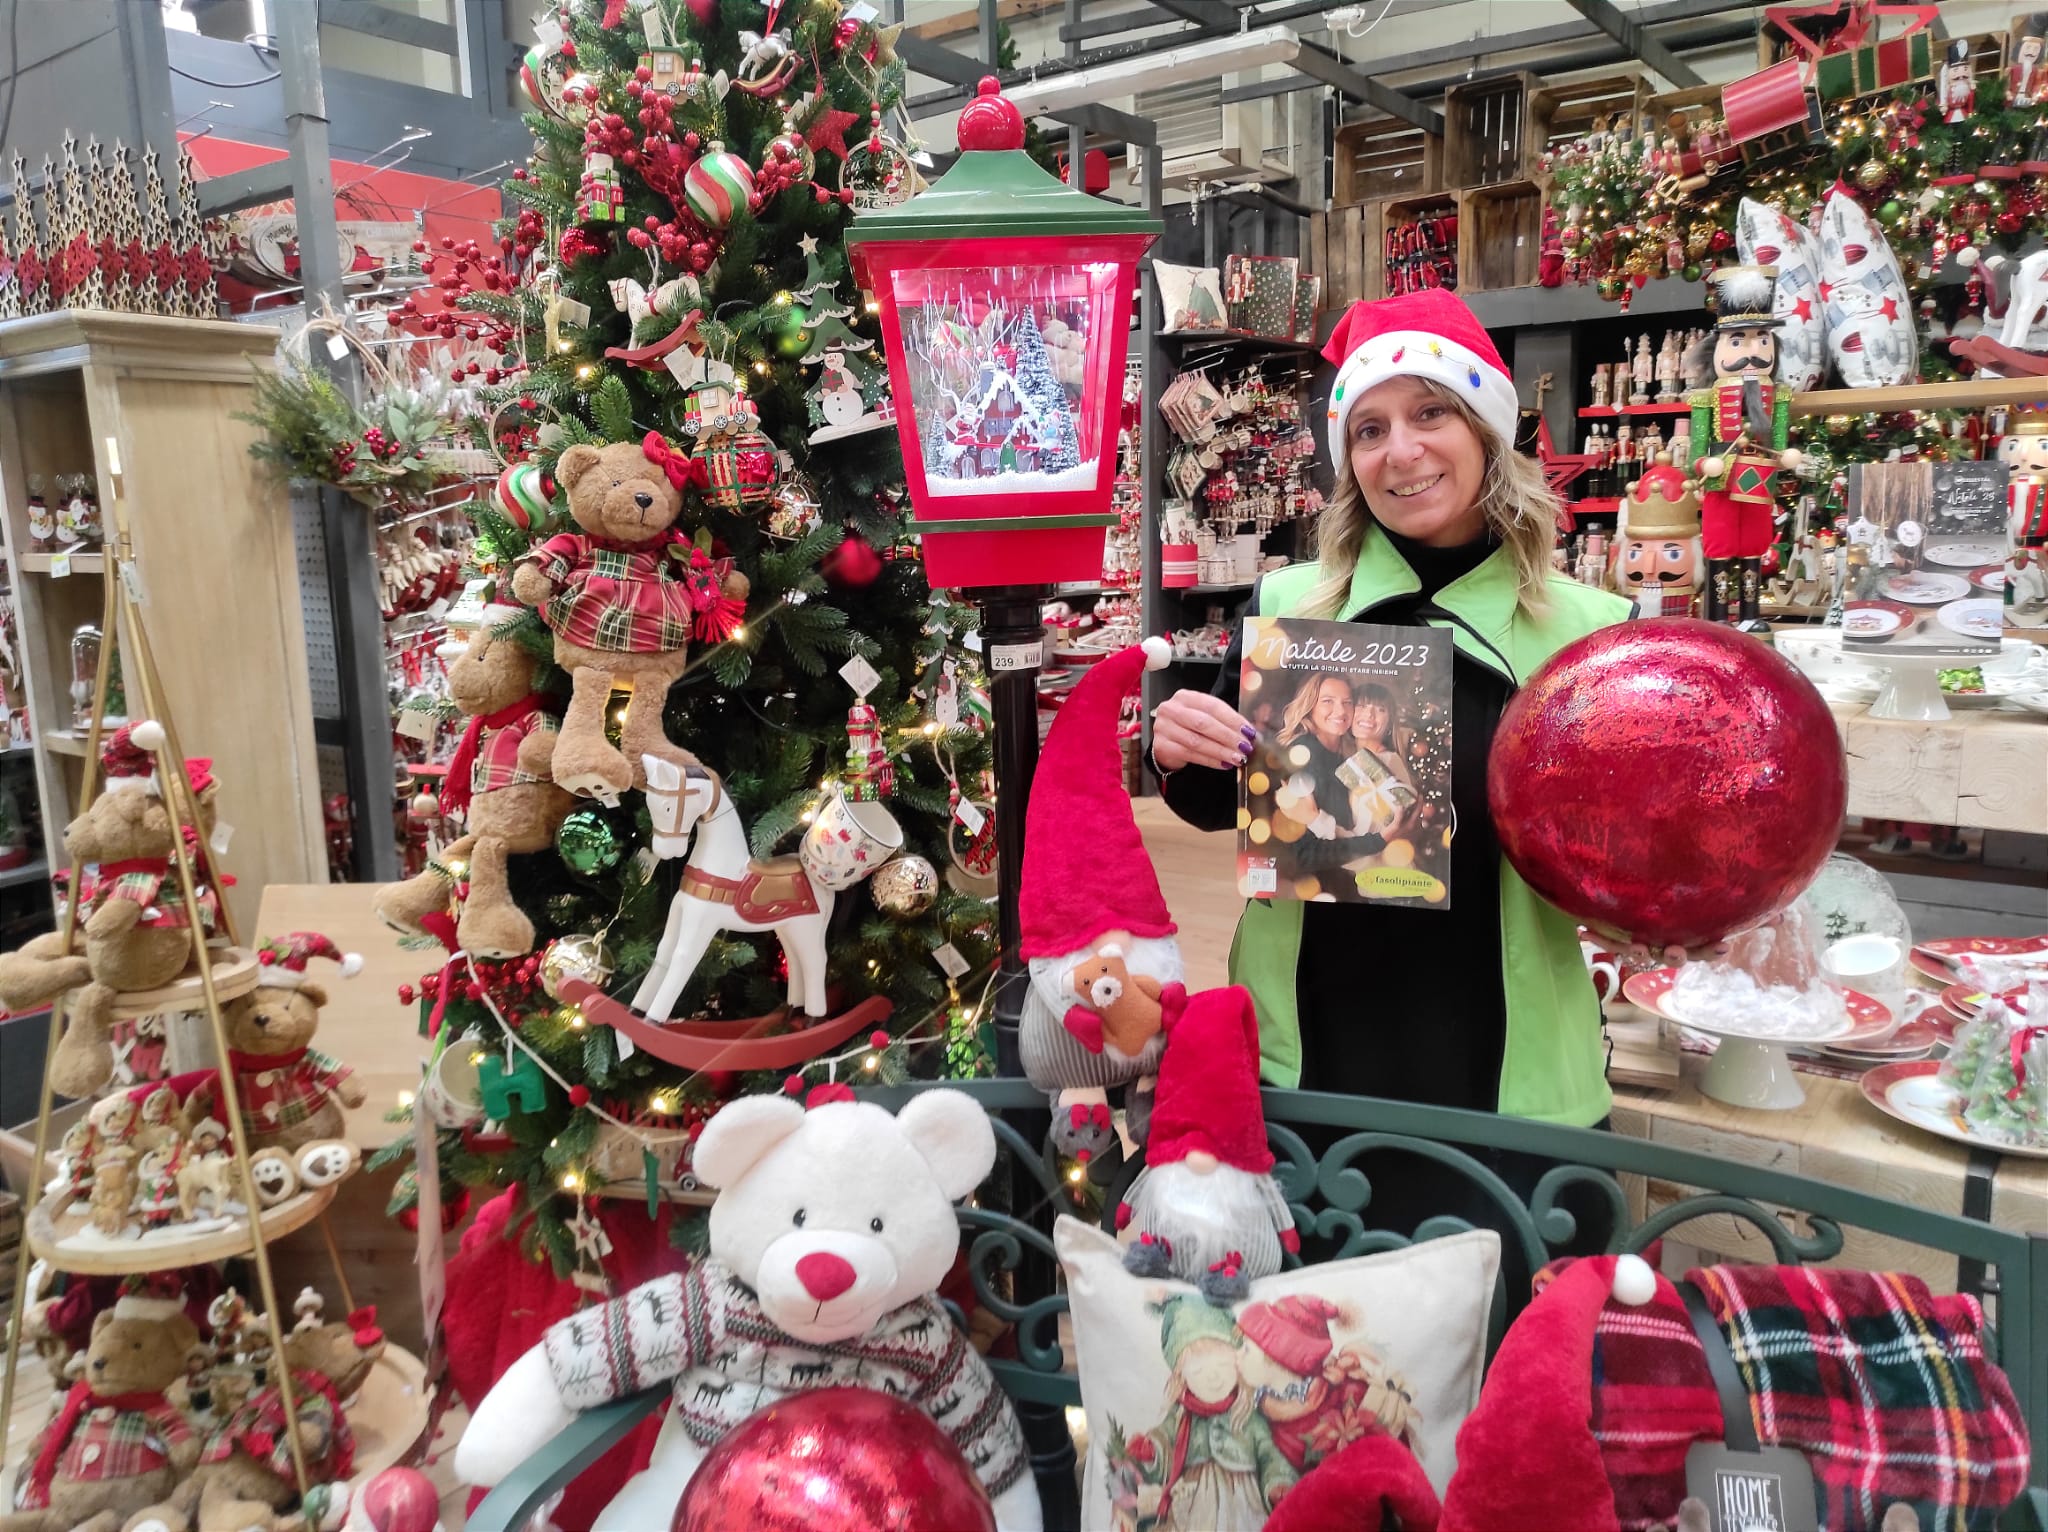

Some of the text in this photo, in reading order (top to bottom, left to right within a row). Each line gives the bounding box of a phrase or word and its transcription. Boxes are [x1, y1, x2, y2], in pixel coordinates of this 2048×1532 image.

[994, 657, 1014, 667] 239
[1259, 636, 1430, 669] Natale 2023
[1287, 663, 1309, 671] TUTTA
[1722, 1475, 1774, 1520] HOME
